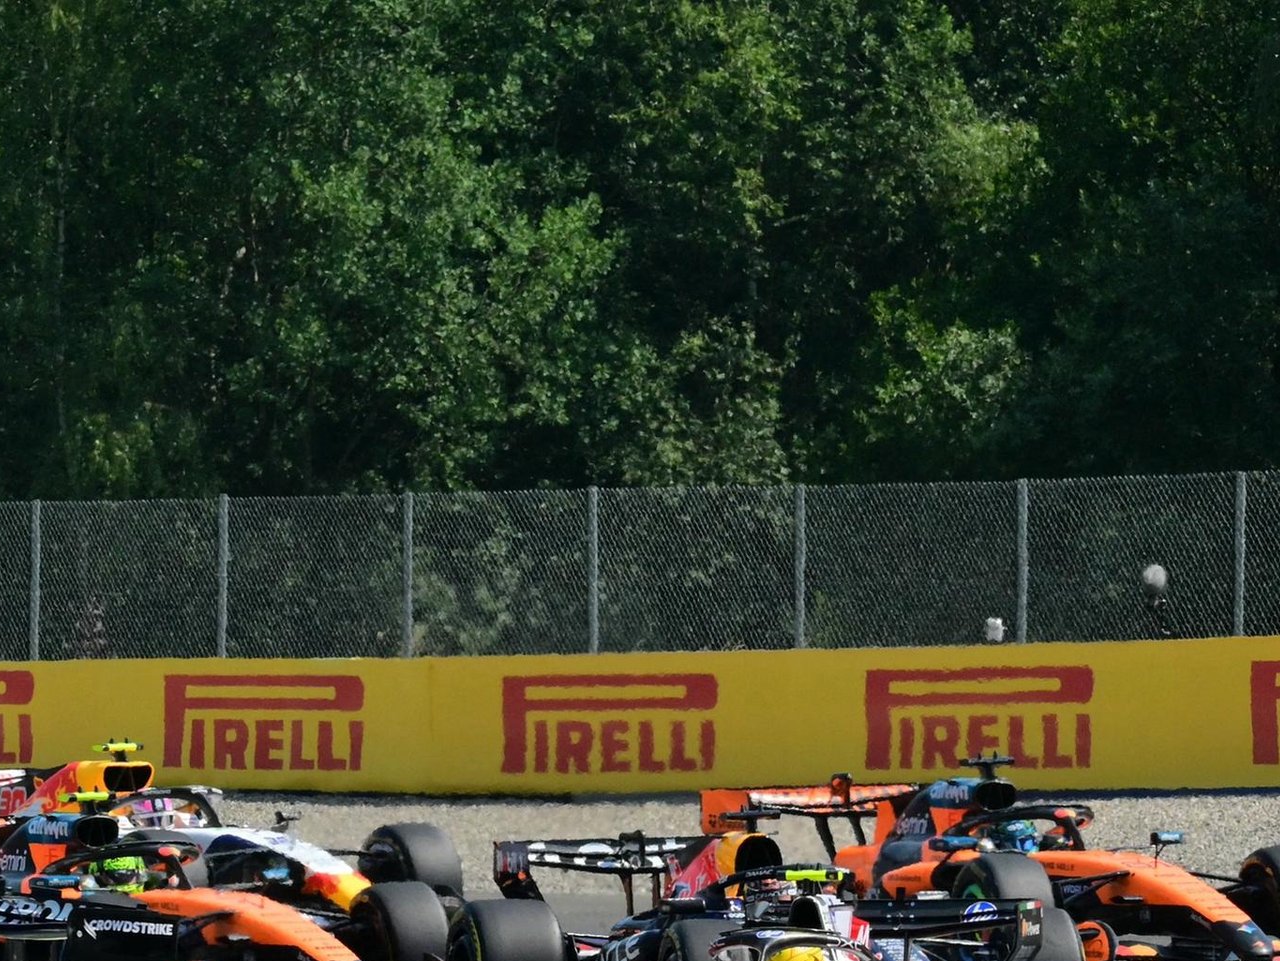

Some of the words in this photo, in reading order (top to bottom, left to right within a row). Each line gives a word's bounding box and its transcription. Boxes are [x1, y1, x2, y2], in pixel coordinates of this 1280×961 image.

[163, 674, 365, 772] PIRELLI
[502, 674, 719, 773] PIRELLI
[865, 665, 1094, 770] PIRELLI
[89, 919, 174, 936] CROWDSTRIKE
